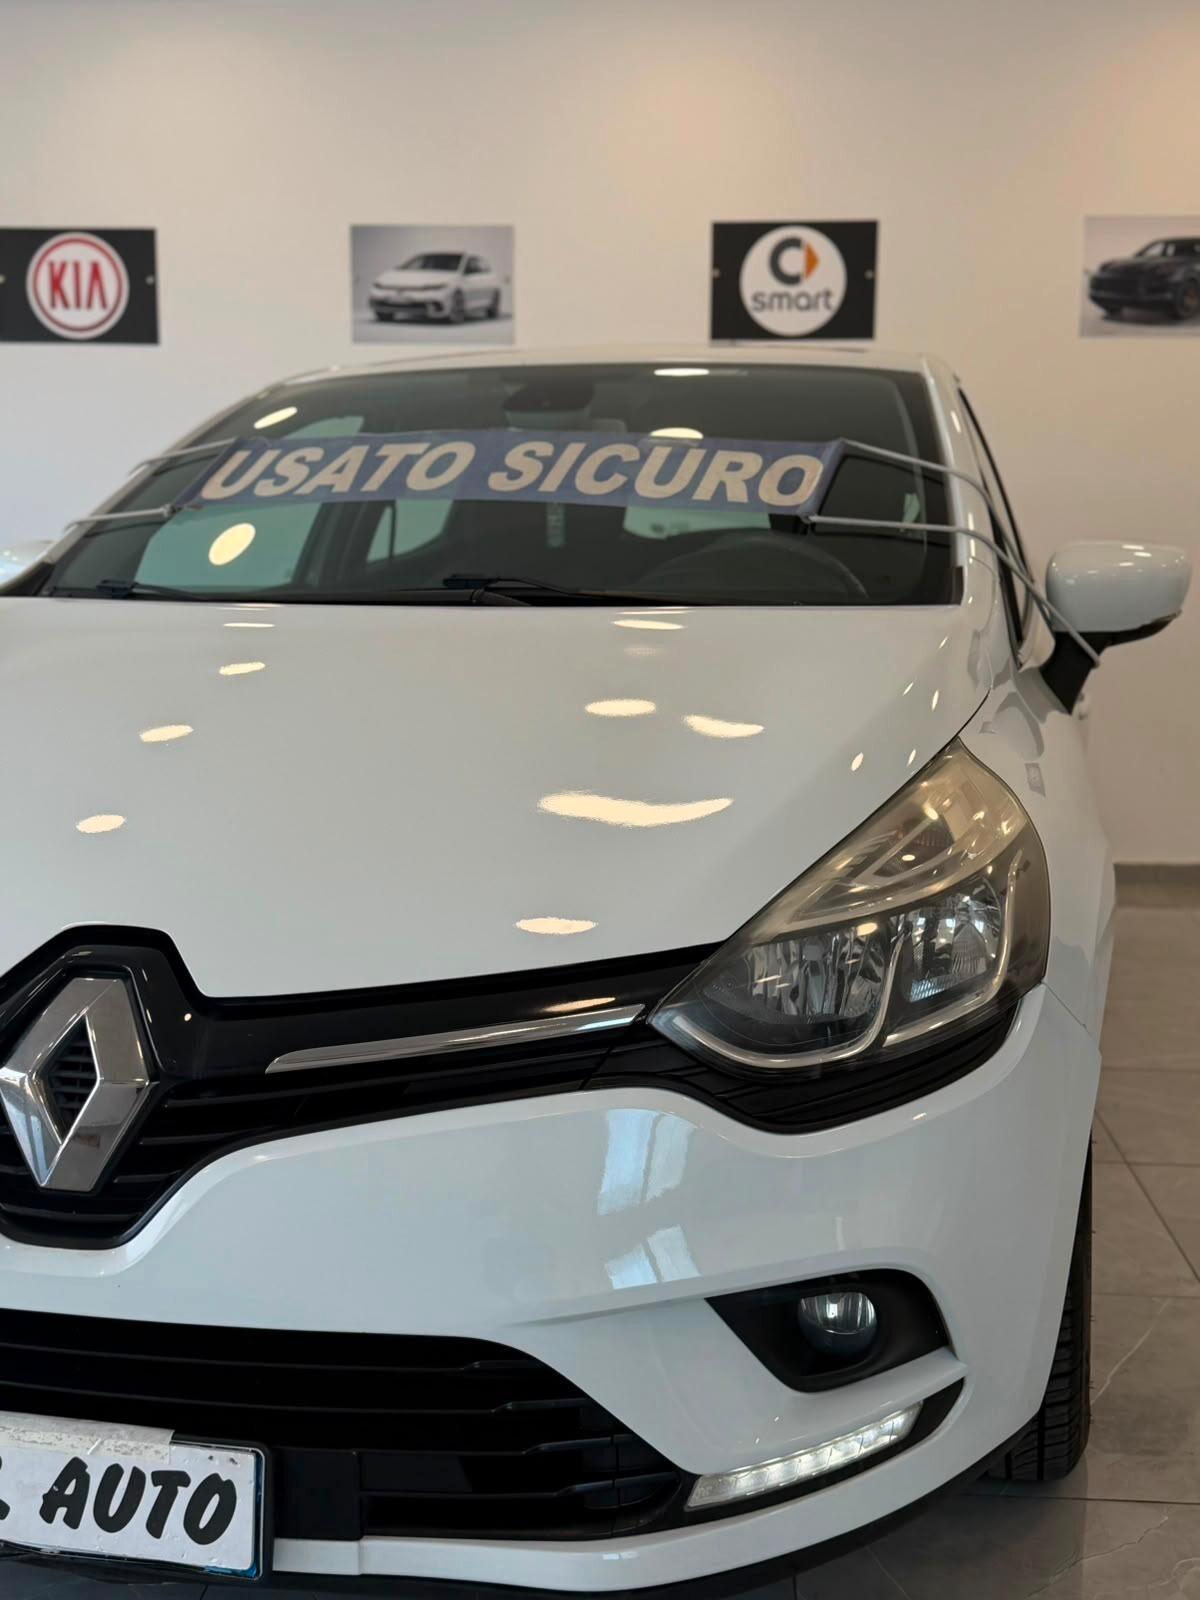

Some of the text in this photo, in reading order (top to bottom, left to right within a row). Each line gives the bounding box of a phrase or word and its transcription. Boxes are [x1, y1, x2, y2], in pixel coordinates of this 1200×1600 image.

[48, 261, 107, 310] KIA
[751, 289, 833, 312] smart
[201, 441, 824, 507] USATO SICURO
[39, 1456, 237, 1545] AUTO
